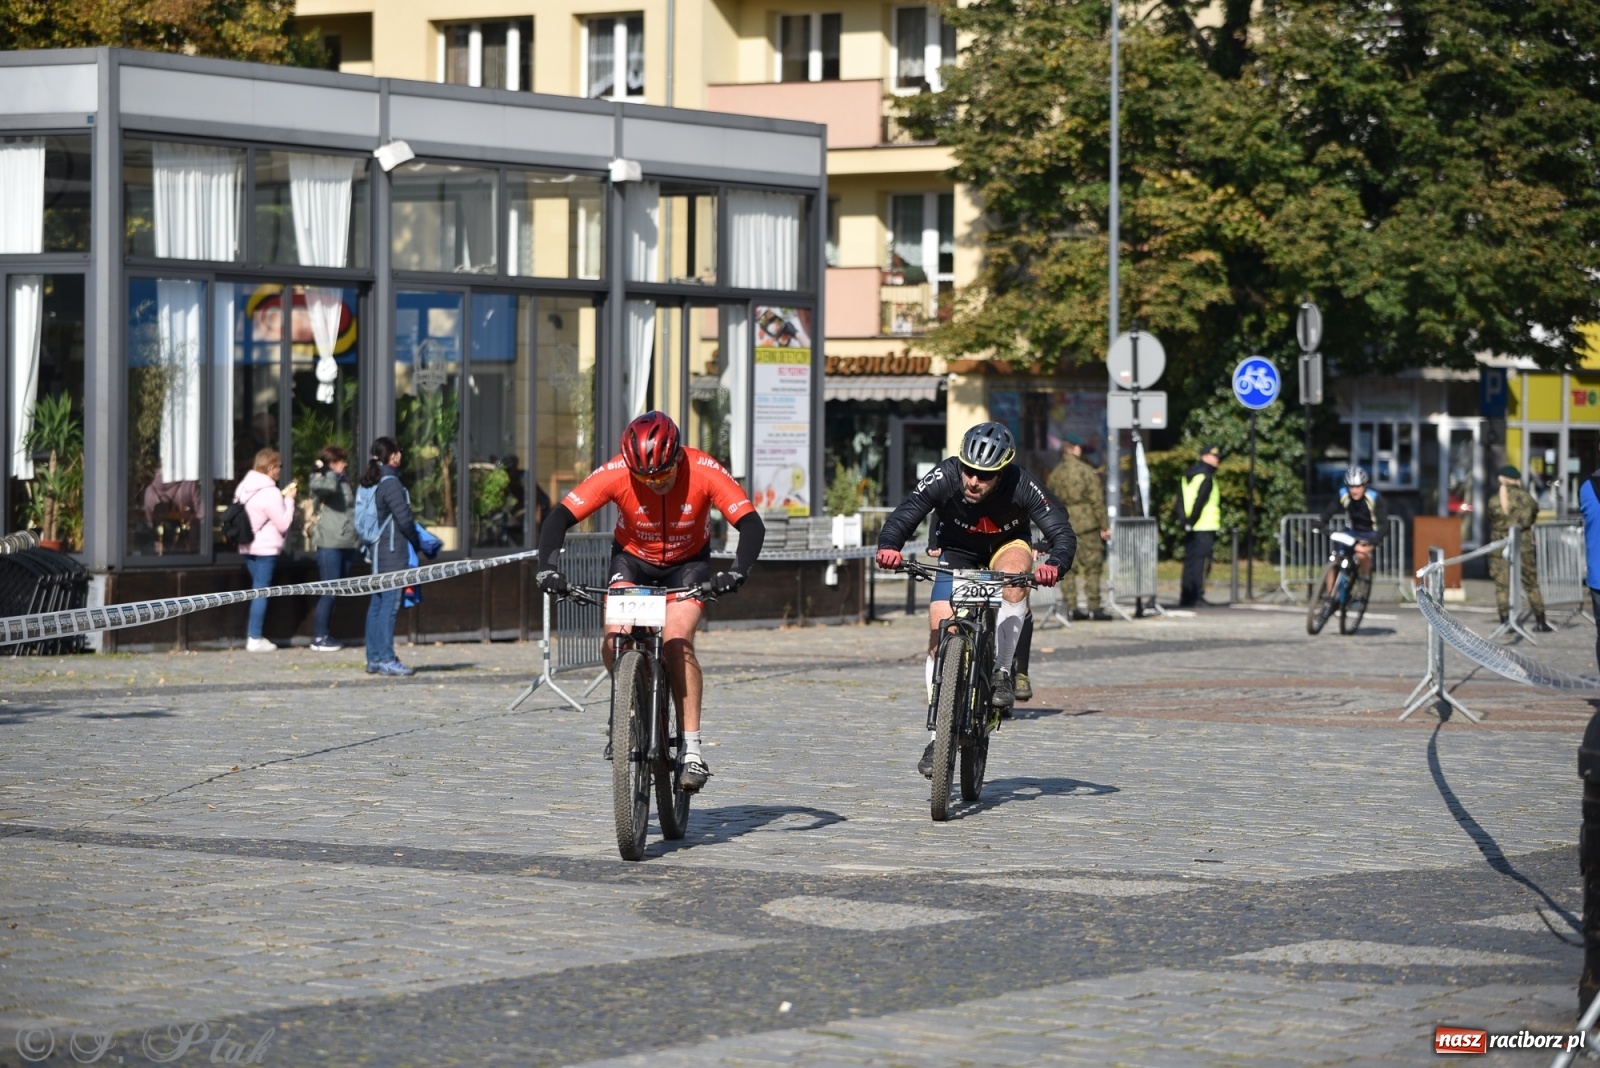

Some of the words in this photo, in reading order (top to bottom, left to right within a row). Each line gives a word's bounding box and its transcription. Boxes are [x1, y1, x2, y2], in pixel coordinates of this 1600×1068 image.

[1486, 371, 1502, 403] P
[696, 456, 719, 470] JURA
[961, 586, 996, 598] 2002
